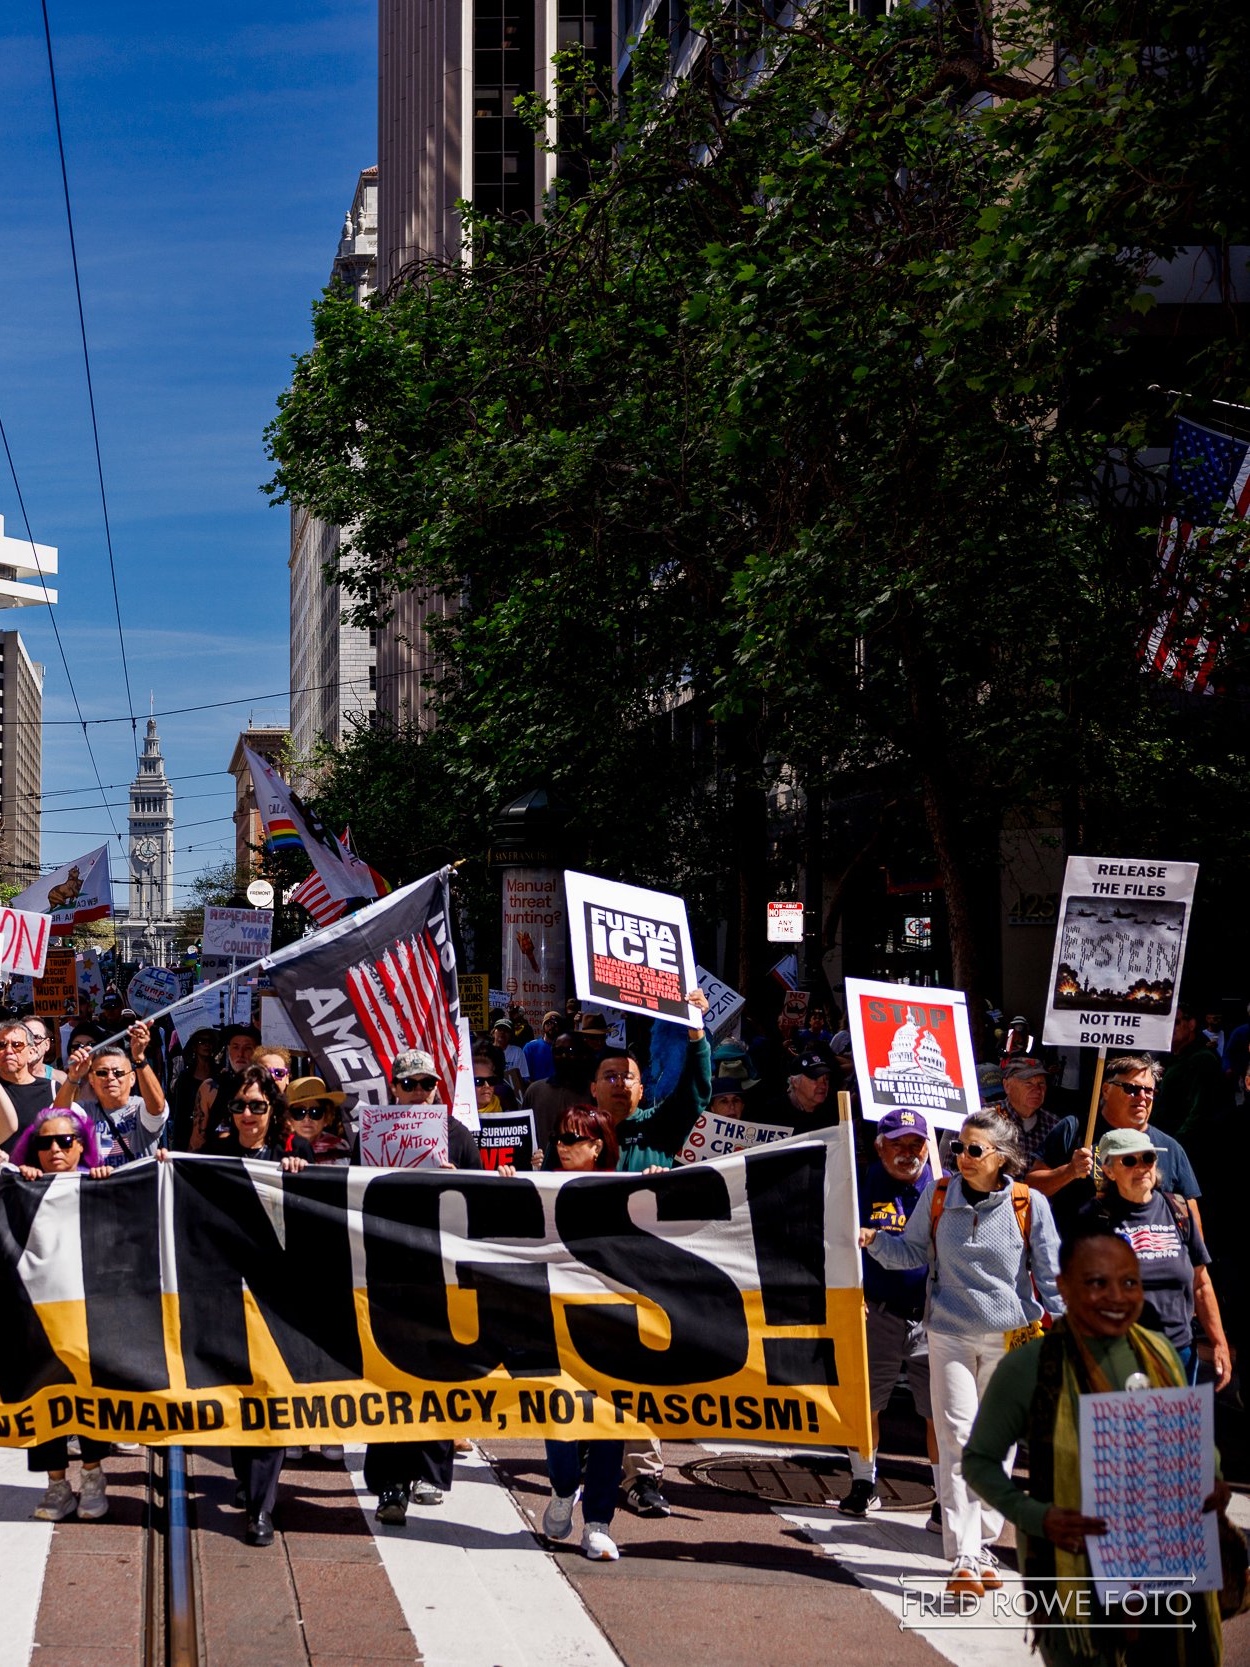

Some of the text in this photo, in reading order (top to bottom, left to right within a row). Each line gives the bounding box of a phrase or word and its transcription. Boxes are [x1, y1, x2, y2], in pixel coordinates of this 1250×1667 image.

[1097, 864, 1167, 879] RELEASE
[507, 878, 557, 893] Manual
[1092, 882, 1166, 898] THE FILES
[510, 894, 552, 908] threat
[209, 908, 273, 925] REMEMBER
[503, 909, 562, 928] hunting?
[770, 909, 779, 917] NO
[590, 906, 677, 944] FUERA
[240, 926, 270, 941] YOUR
[222, 940, 270, 956] COUNTRY
[591, 923, 680, 975] ICE
[49, 959, 72, 967] TRUMP
[593, 953, 680, 982] LEVANTADXS POR
[594, 961, 638, 977] NUESTROS
[44, 967, 68, 976] ASCIST
[145, 967, 176, 986] ICE
[594, 967, 641, 986] NUESTRA
[458, 975, 484, 985] NGRESS:
[522, 981, 556, 994] tines
[36, 985, 75, 996] MUST GO
[595, 974, 641, 992] NUESTRO
[642, 985, 682, 1002] FUTURO
[35, 999, 62, 1012] NOW!
[868, 1000, 947, 1030] STOP
[1079, 1013, 1141, 1028] NOT THE
[1079, 1032, 1136, 1046] BOMBS
[874, 1079, 962, 1101] THE BILLIONAIRE
[893, 1091, 948, 1109] TAKEOVER
[372, 1111, 443, 1125] IMMIGRATION
[391, 1122, 423, 1132] BUILT
[481, 1124, 528, 1137] SURVIVORS
[399, 1134, 440, 1150] NATION
[480, 1136, 523, 1148] SILENCED,
[48, 1395, 225, 1432] DEMAND
[238, 1388, 508, 1432] DEMOCRACY,
[518, 1388, 598, 1425] NOT
[610, 1389, 820, 1434] FASCISM!
